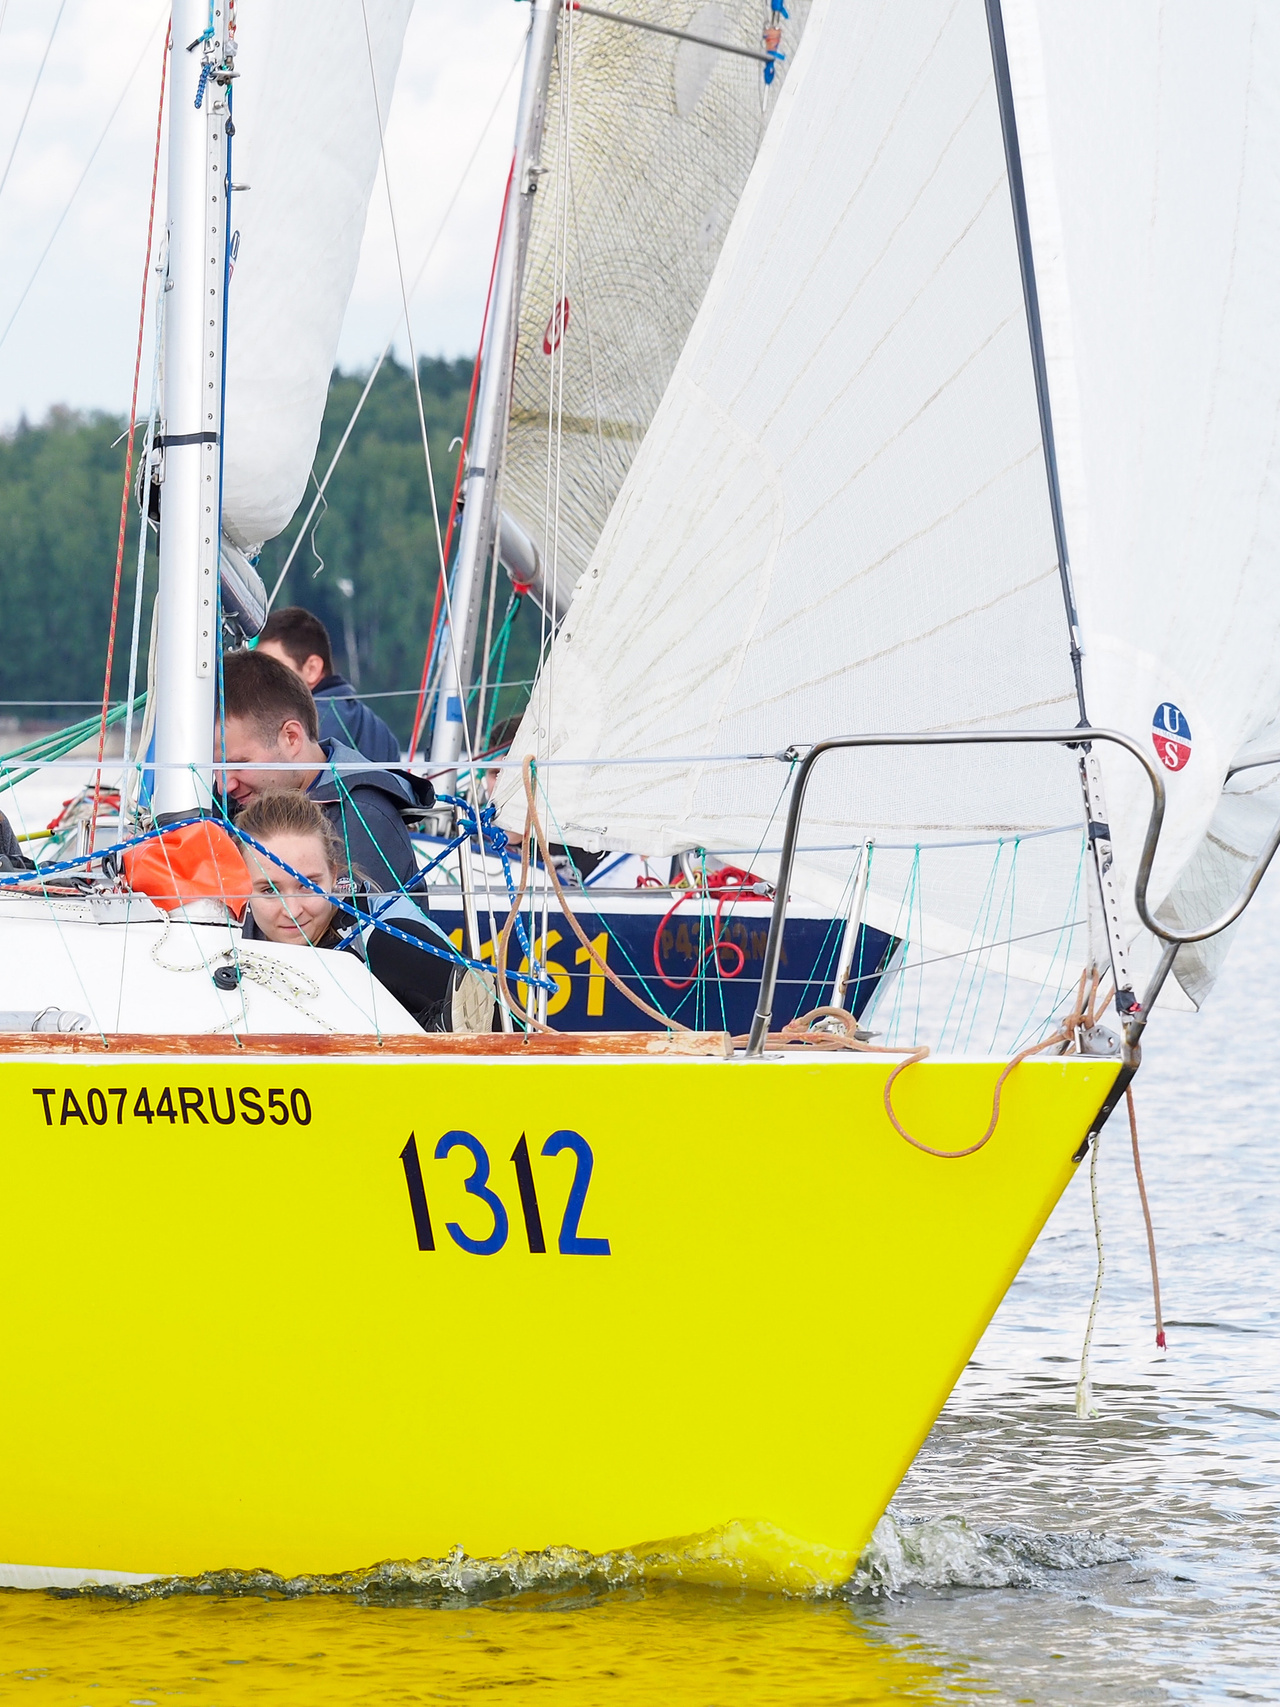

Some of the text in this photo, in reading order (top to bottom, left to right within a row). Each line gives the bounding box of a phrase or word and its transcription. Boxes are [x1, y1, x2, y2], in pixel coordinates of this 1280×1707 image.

[1162, 705, 1181, 733] U
[1164, 741, 1179, 768] S
[449, 928, 608, 1016] 161
[33, 1086, 312, 1126] TA0744RUS50
[399, 1130, 611, 1256] 1312
